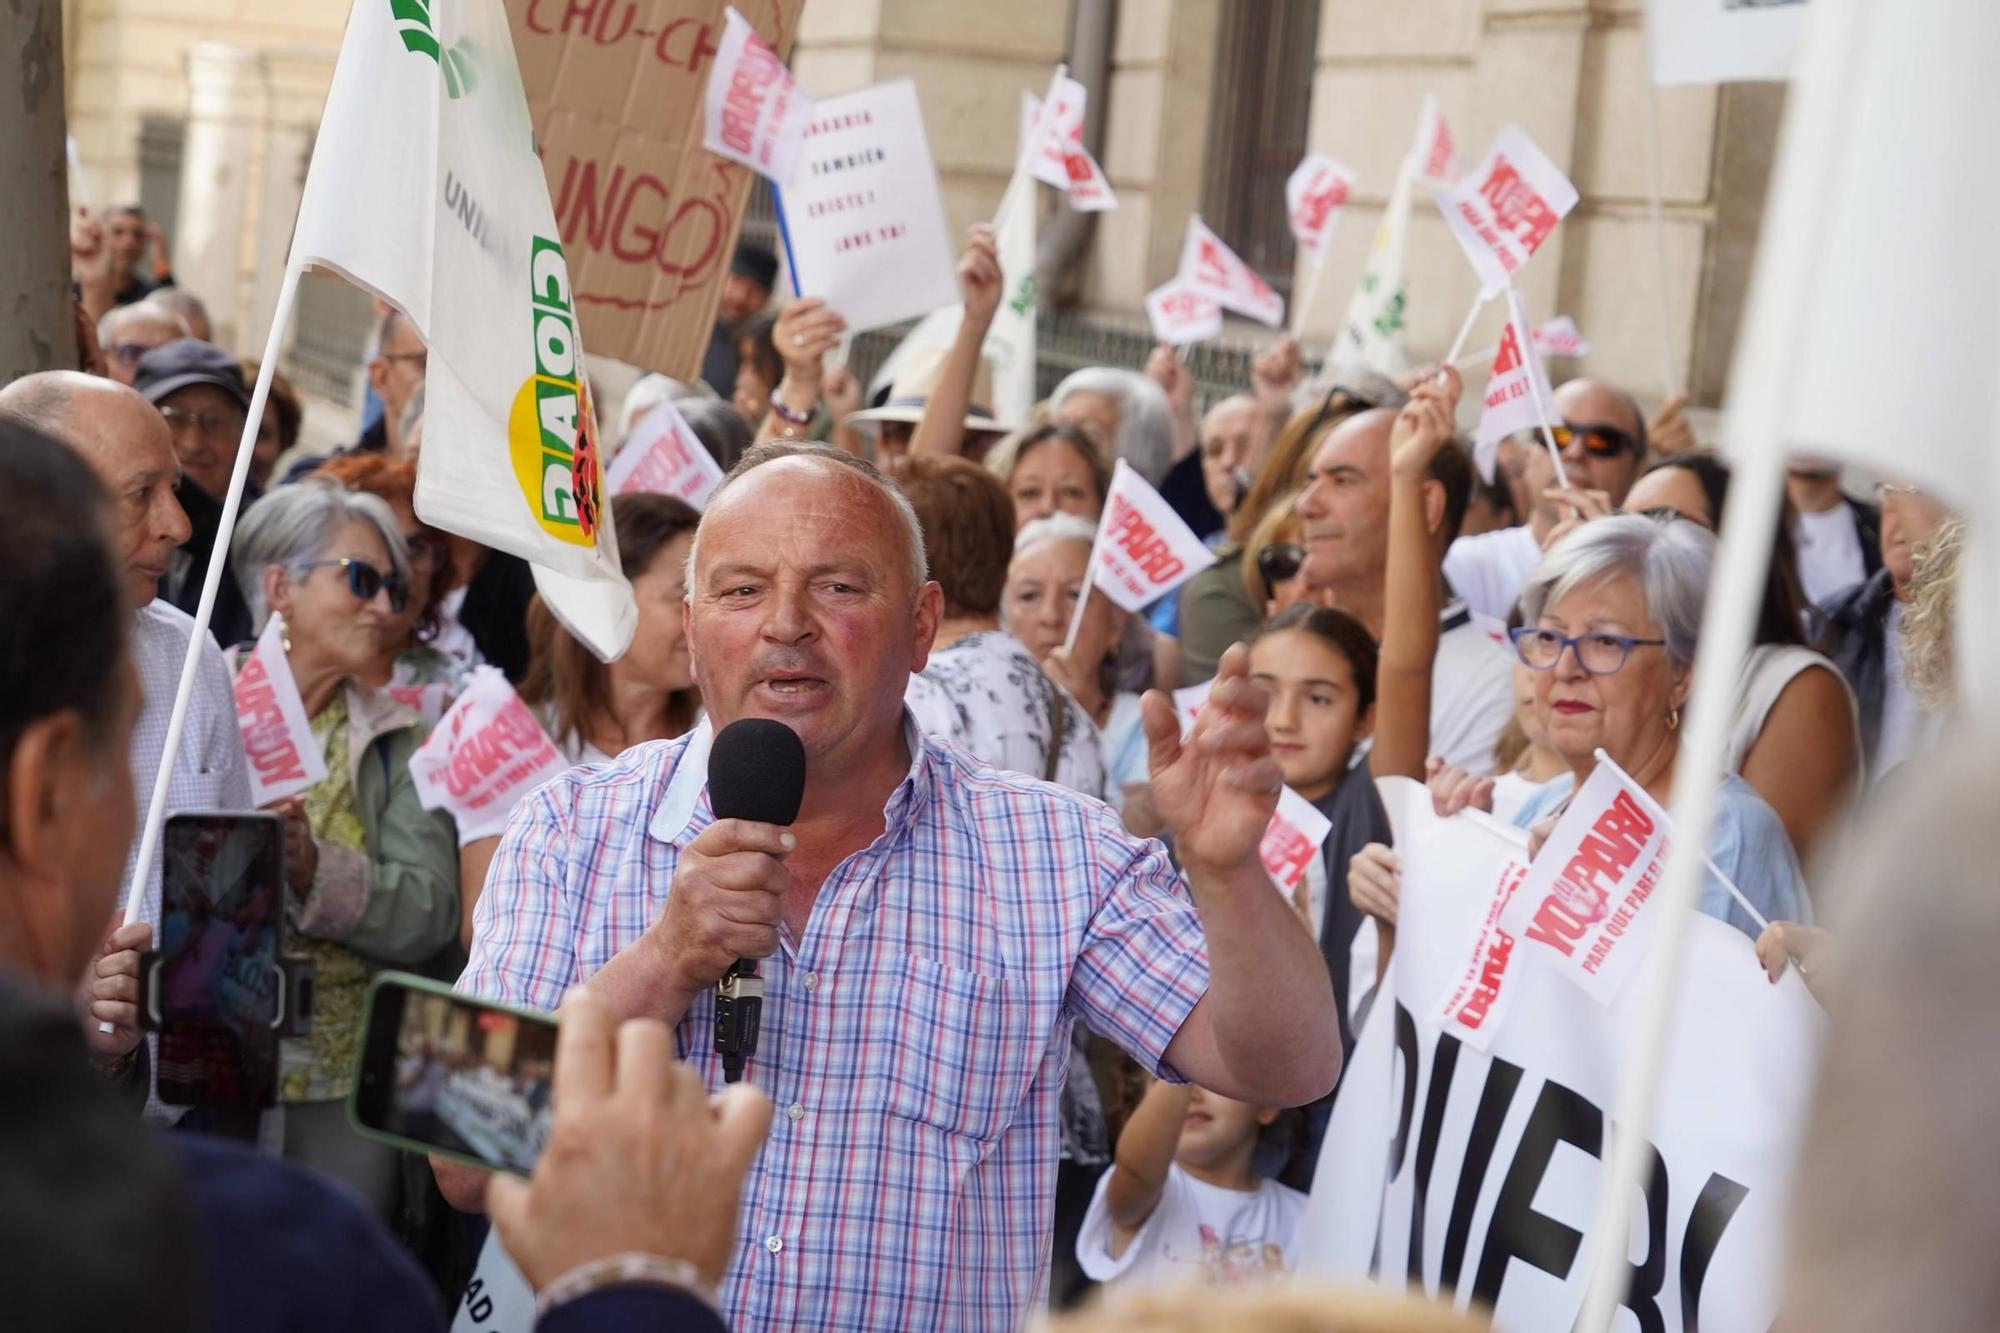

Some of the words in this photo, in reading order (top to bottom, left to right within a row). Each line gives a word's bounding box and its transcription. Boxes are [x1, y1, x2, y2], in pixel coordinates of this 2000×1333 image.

[1524, 893, 1589, 957] YO
[1561, 788, 1655, 903] PARO
[1457, 926, 1515, 1030] PARO
[1581, 934, 1616, 976] PARA
[1605, 903, 1637, 938] QUE
